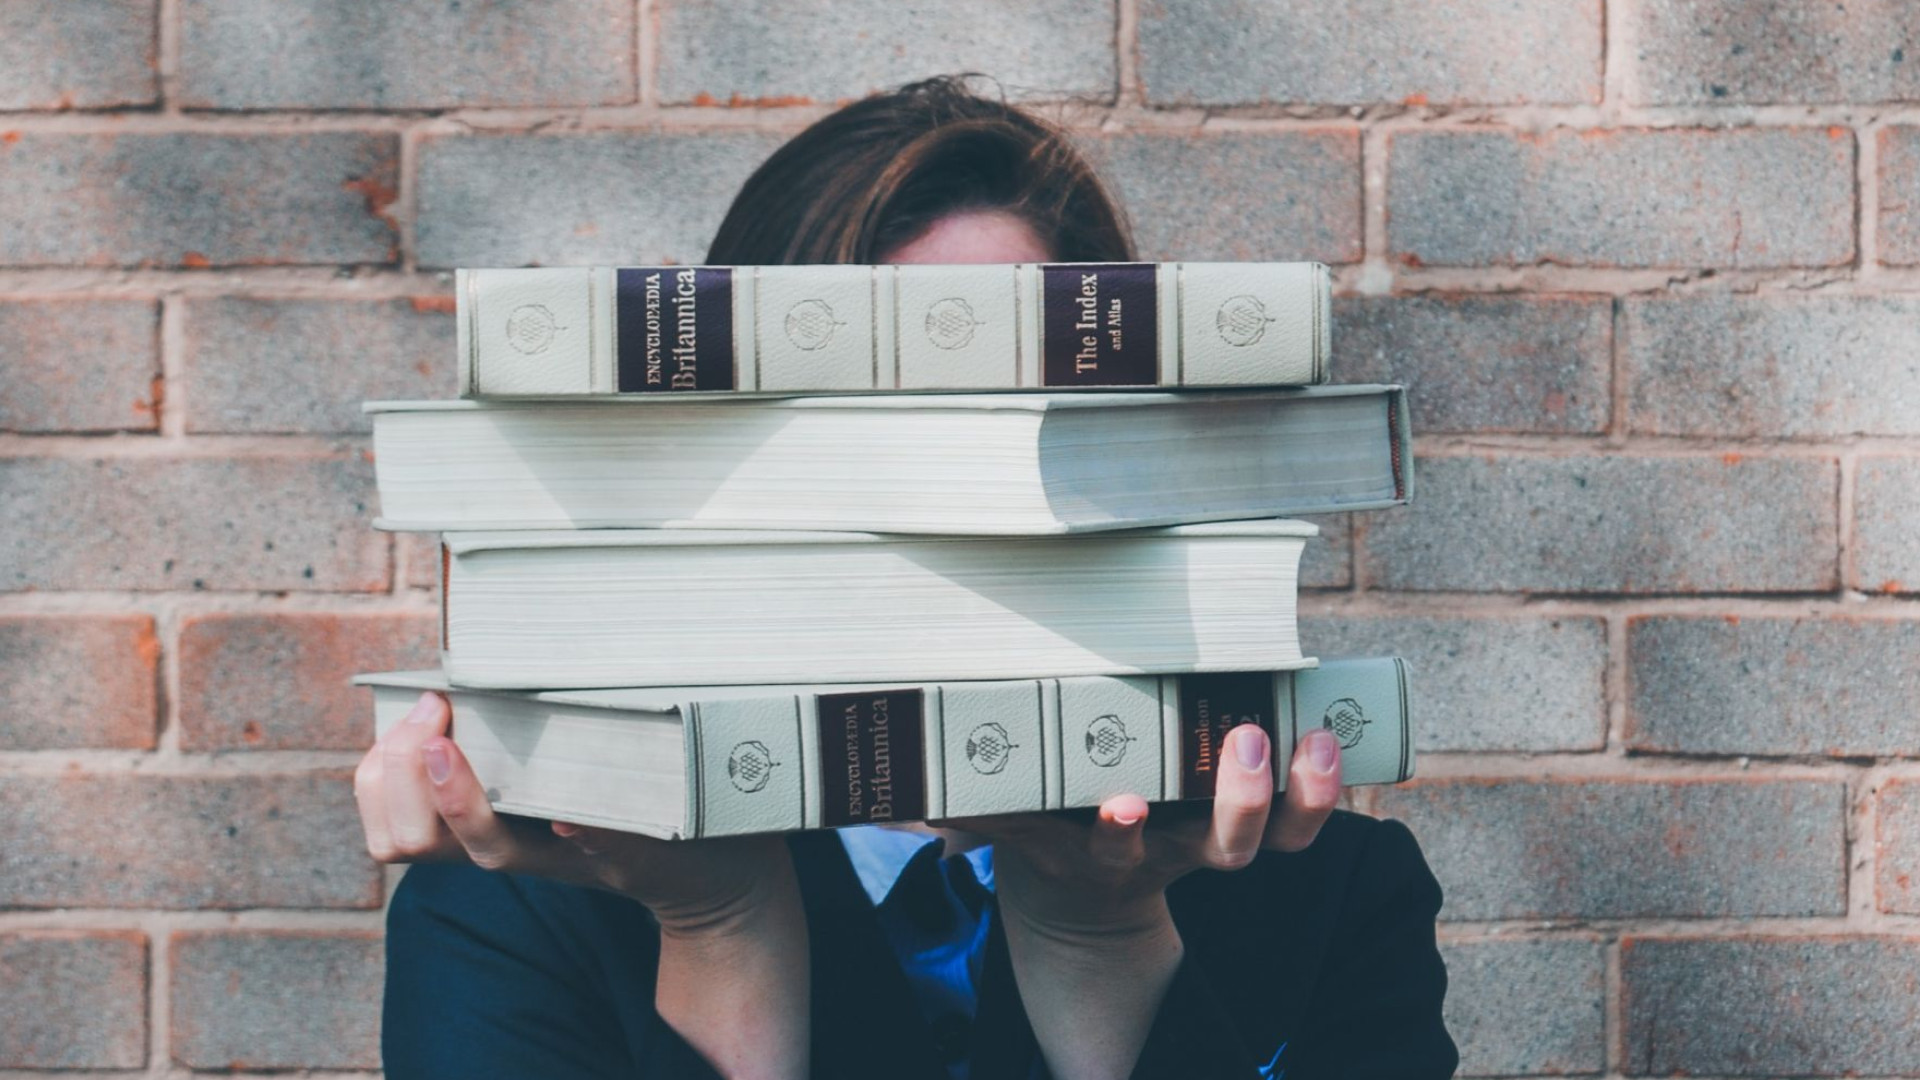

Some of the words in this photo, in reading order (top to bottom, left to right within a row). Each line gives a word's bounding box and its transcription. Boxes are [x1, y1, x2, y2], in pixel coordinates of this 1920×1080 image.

[671, 267, 696, 389] Britannica
[1075, 273, 1098, 330] Index
[1107, 298, 1122, 327] Atlas
[1075, 335, 1098, 374] The
[1108, 329, 1122, 351] and
[869, 697, 893, 820] Britannica
[1194, 699, 1211, 775] Timoleon
